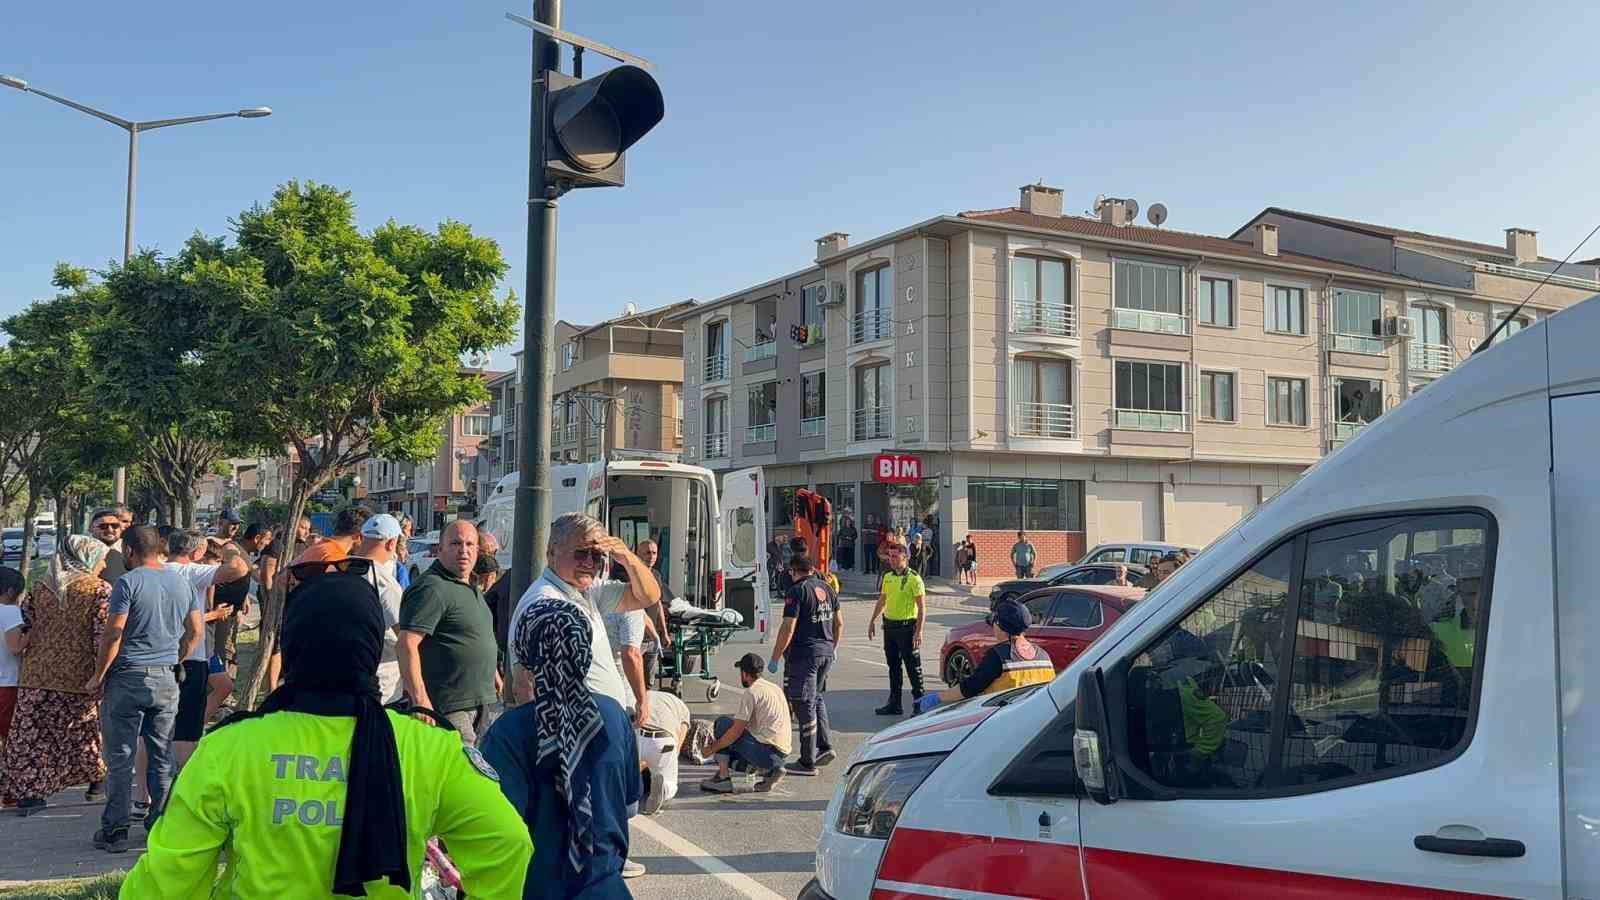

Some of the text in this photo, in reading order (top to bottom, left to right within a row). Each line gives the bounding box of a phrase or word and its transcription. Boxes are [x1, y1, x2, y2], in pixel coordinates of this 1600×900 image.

[879, 455, 918, 479] BİM
[271, 754, 349, 782] TRA
[272, 798, 344, 826] POL
